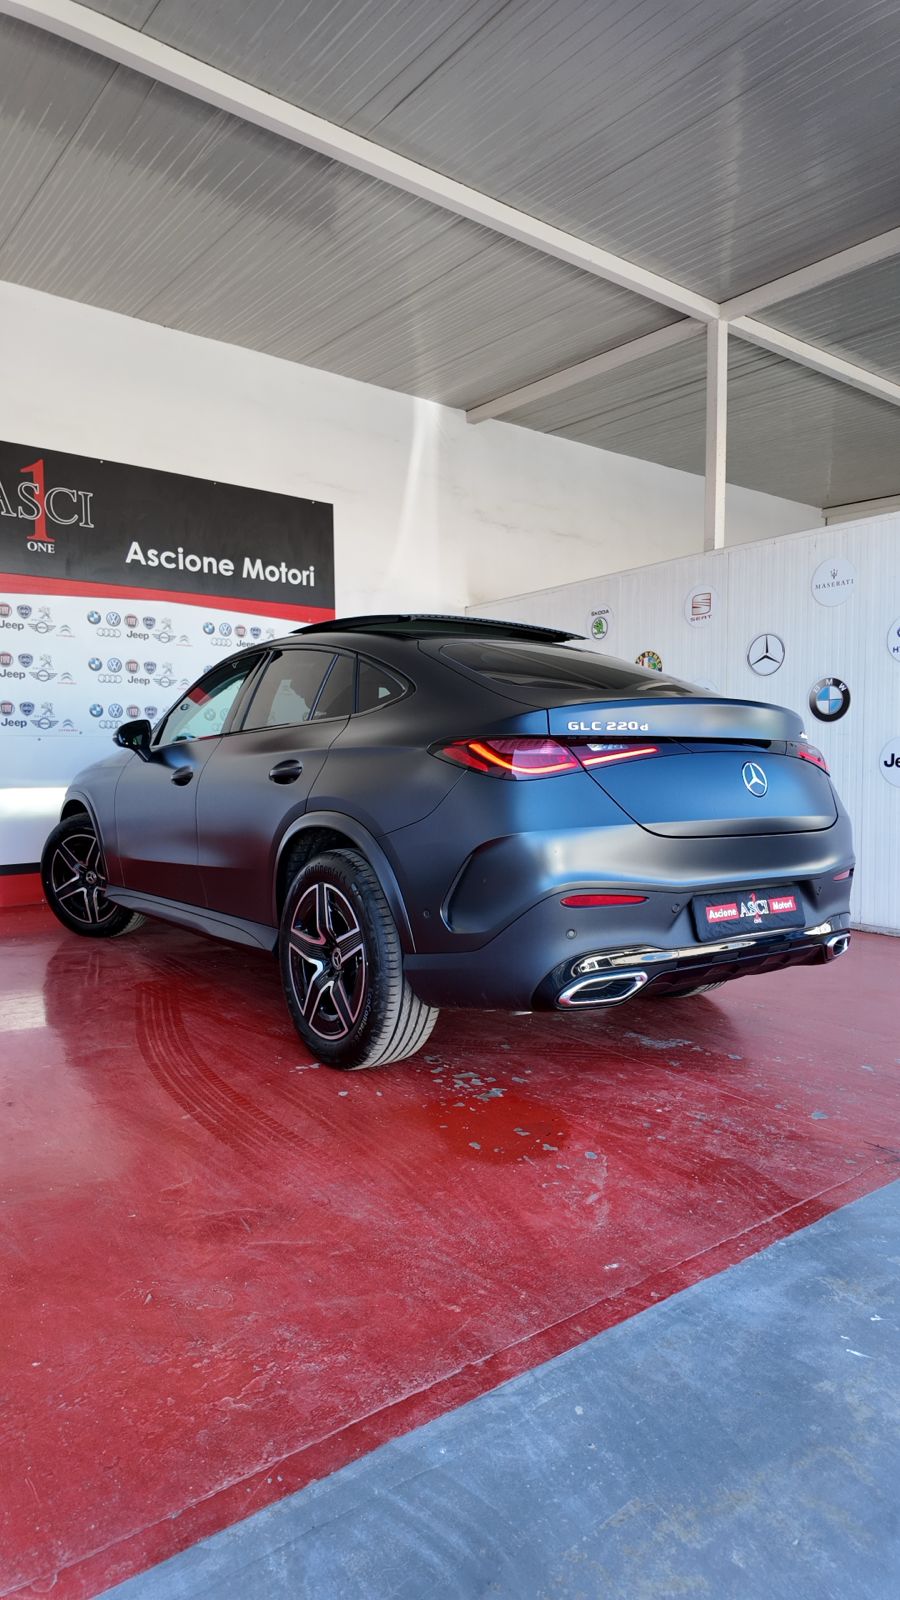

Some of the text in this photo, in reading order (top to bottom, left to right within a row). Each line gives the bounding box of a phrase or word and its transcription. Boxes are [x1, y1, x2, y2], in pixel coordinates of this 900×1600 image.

[26, 541, 55, 554] ONE
[125, 541, 315, 587] Ascione Motori
[814, 578, 854, 590] MASERATI
[0, 620, 25, 631] Jeep
[126, 630, 150, 640] Jeep
[0, 669, 26, 680] Jeep
[127, 676, 150, 686] Jeep
[1, 718, 27, 729] Jeep
[567, 721, 649, 731] GLC 220d
[709, 899, 793, 919] Ascione ASCI Motori
